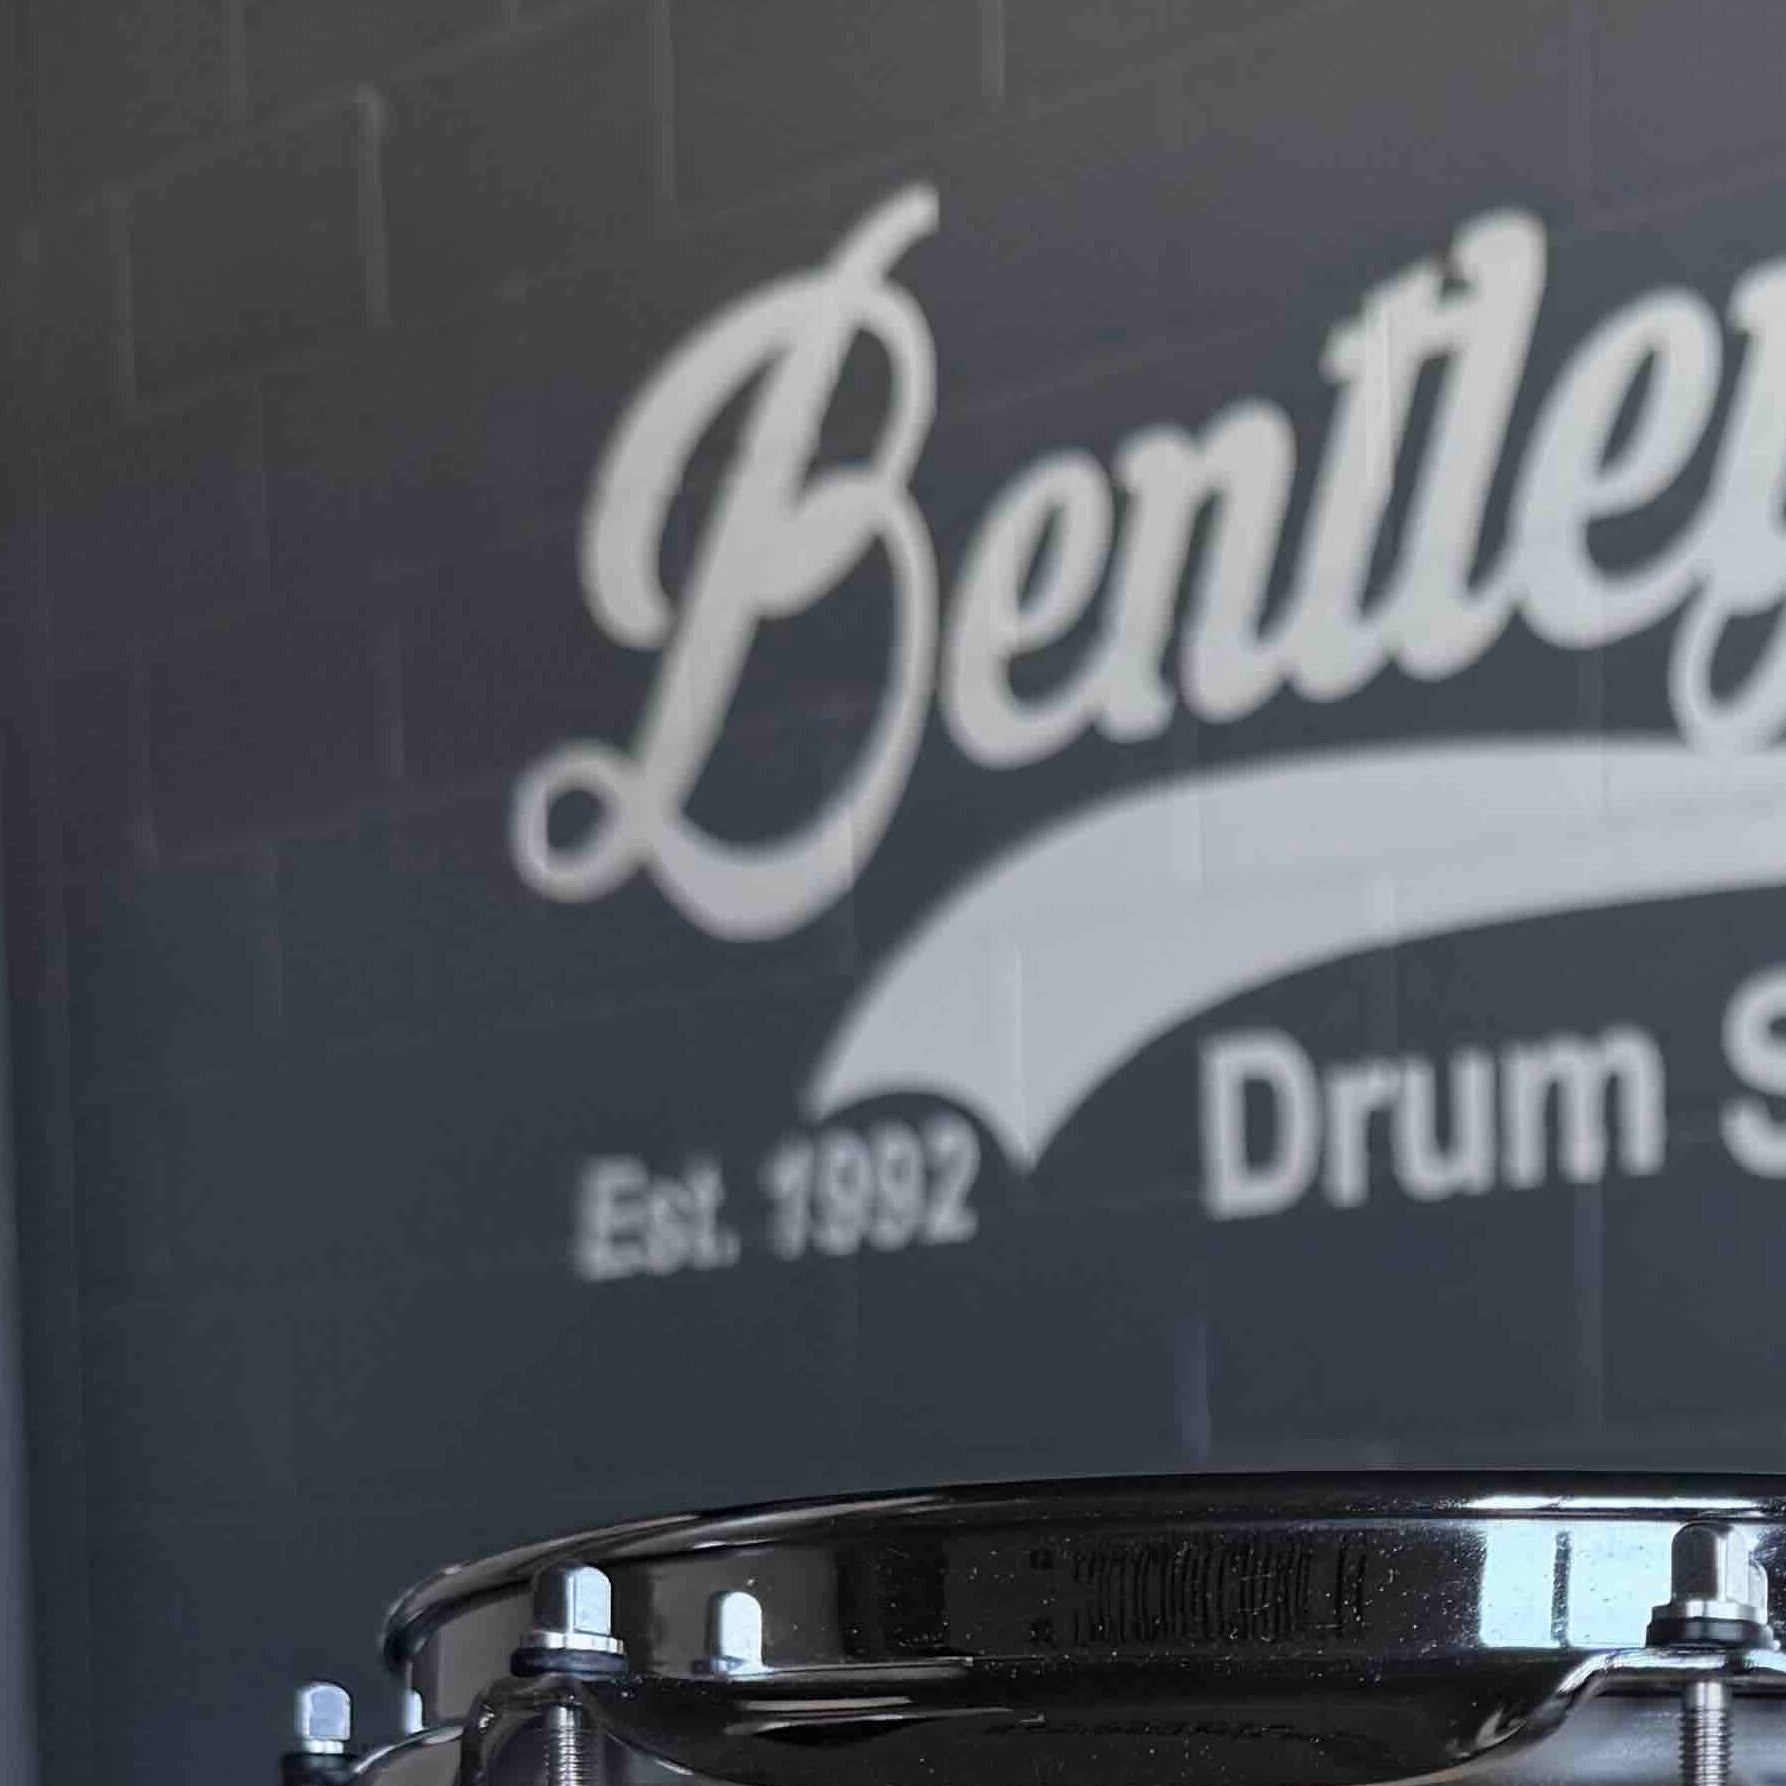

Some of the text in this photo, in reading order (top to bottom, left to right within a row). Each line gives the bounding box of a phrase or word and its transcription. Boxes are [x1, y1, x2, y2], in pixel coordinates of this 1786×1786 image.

[576, 1108, 982, 1282] Est. 1992
[1203, 1028, 1665, 1220] Drum
